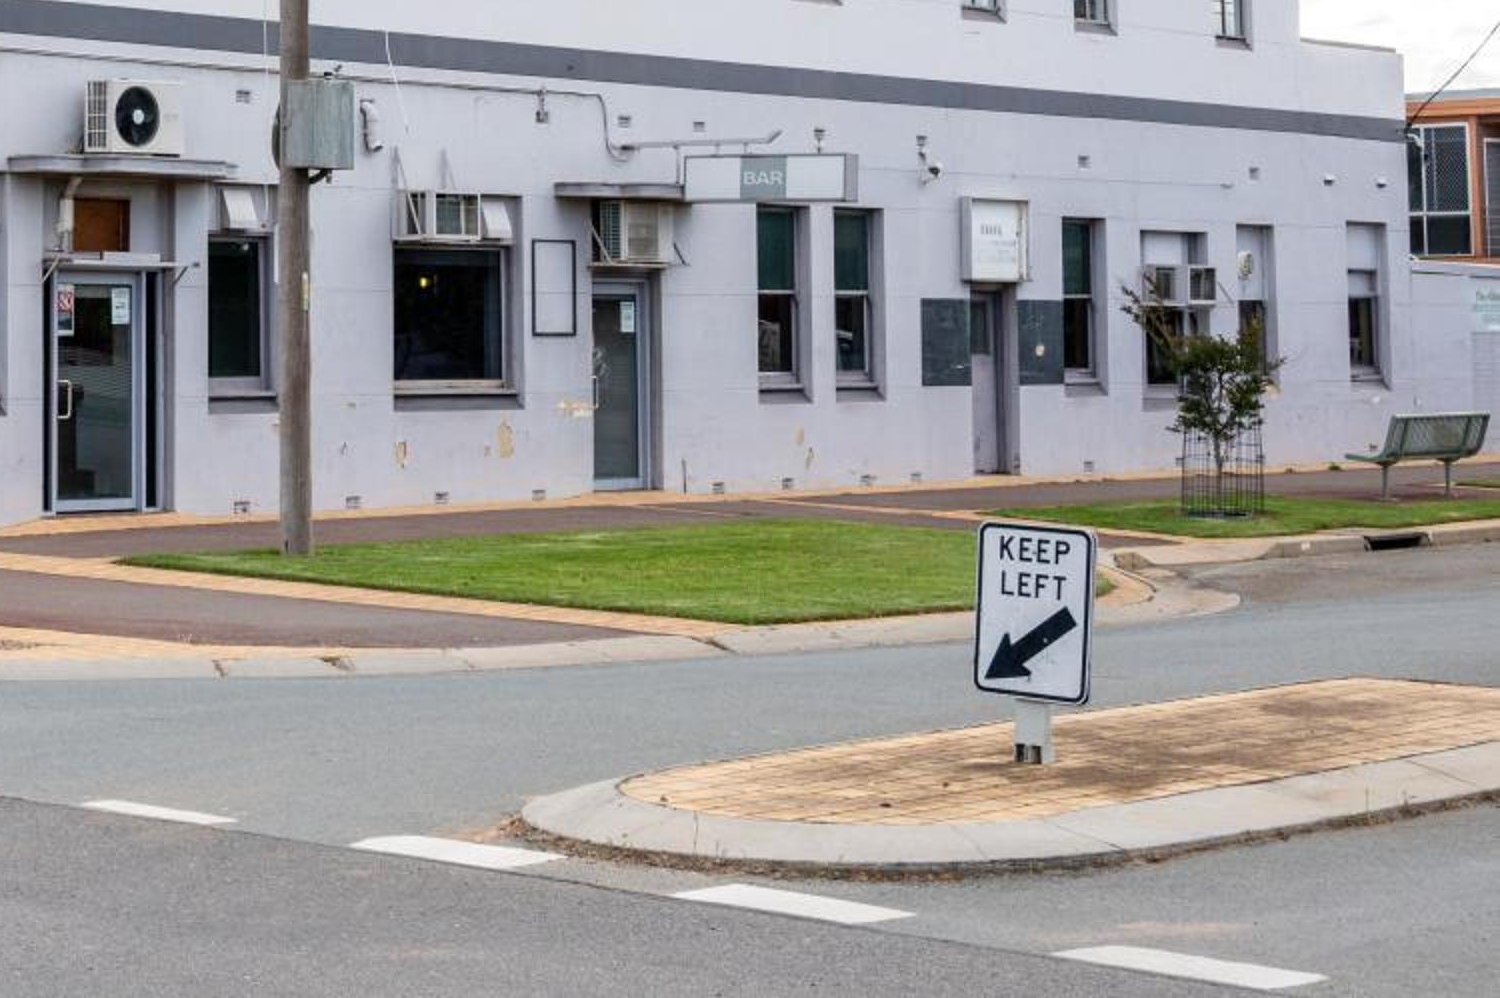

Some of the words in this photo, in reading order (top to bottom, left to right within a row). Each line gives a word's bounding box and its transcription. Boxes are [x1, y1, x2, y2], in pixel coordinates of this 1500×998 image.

[743, 171, 783, 186] BAR
[999, 534, 1070, 564] KEEP
[1000, 570, 1066, 600] LEFT
